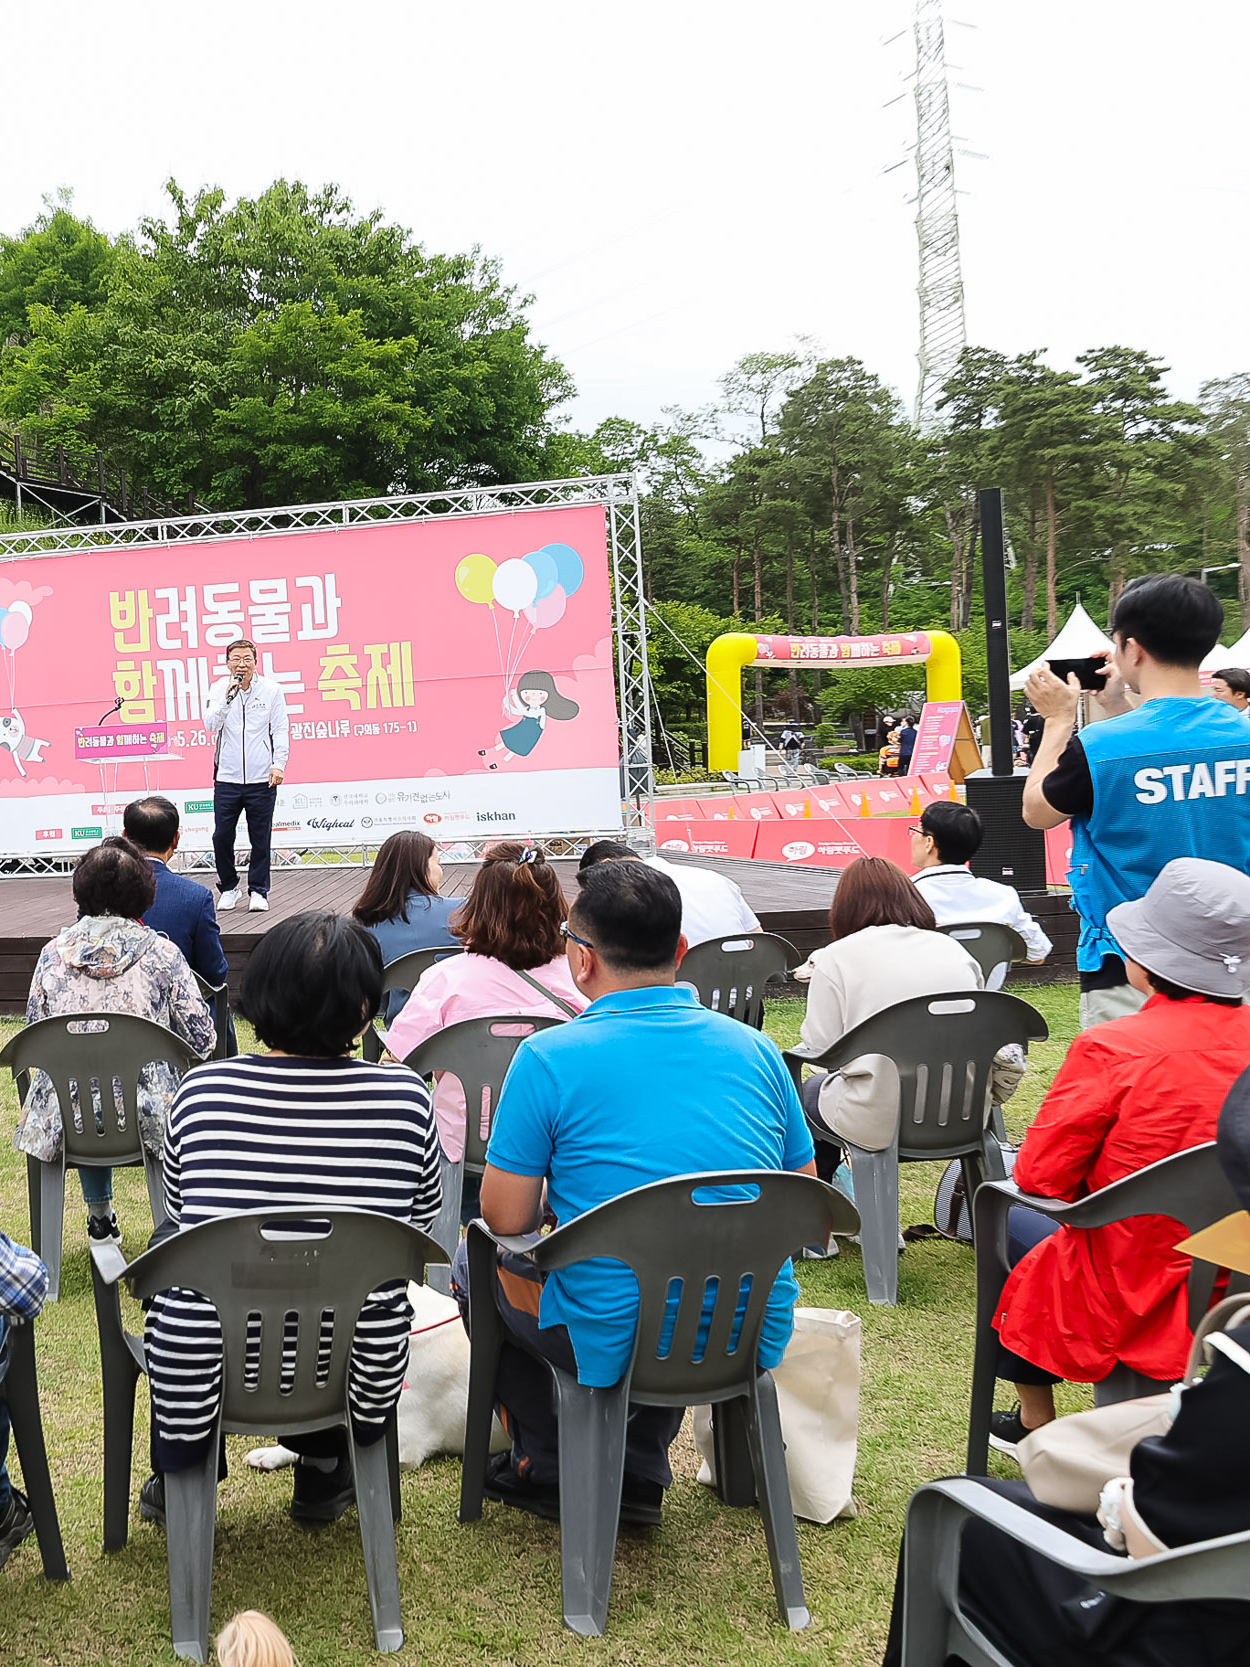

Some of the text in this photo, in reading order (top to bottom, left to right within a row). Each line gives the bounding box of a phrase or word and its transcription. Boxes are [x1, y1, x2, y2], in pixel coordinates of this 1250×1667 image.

[109, 573, 342, 653] 반려동물과
[790, 643, 839, 658] 반려동물과
[317, 641, 415, 711] 축제
[78, 732, 166, 748] 반려동물과 함께하는 축제
[290, 720, 418, 740] 광진숲나루 (구의동 175-1)
[1134, 759, 1250, 804] STAFF
[477, 811, 517, 821] iskhan
